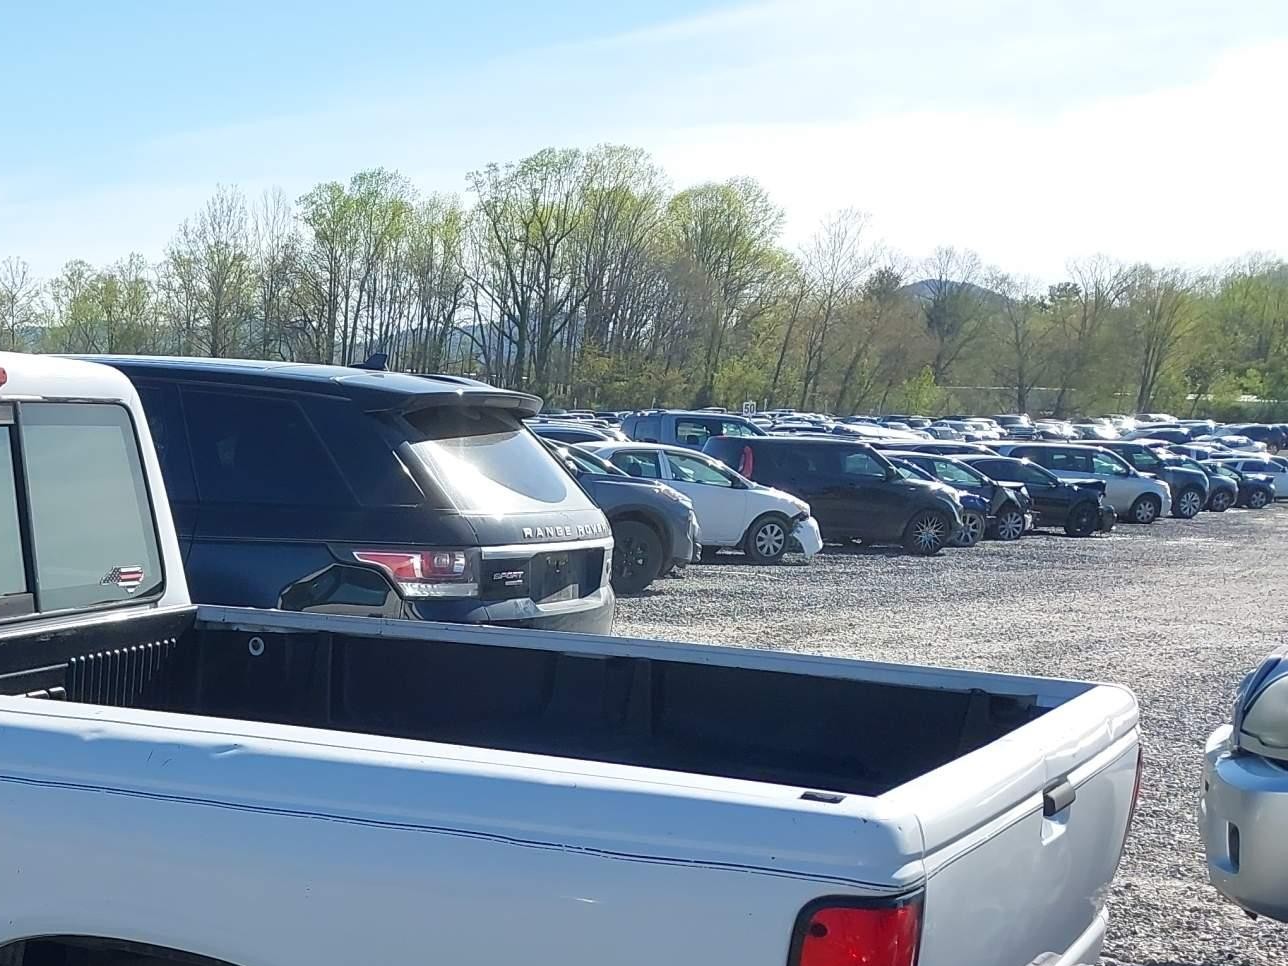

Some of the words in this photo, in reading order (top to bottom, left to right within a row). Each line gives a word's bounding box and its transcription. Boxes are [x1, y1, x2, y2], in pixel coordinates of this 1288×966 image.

[743, 403, 755, 414] 50
[522, 526, 572, 539] RANGE
[577, 523, 608, 537] ROVER
[492, 571, 525, 580] SPORT
